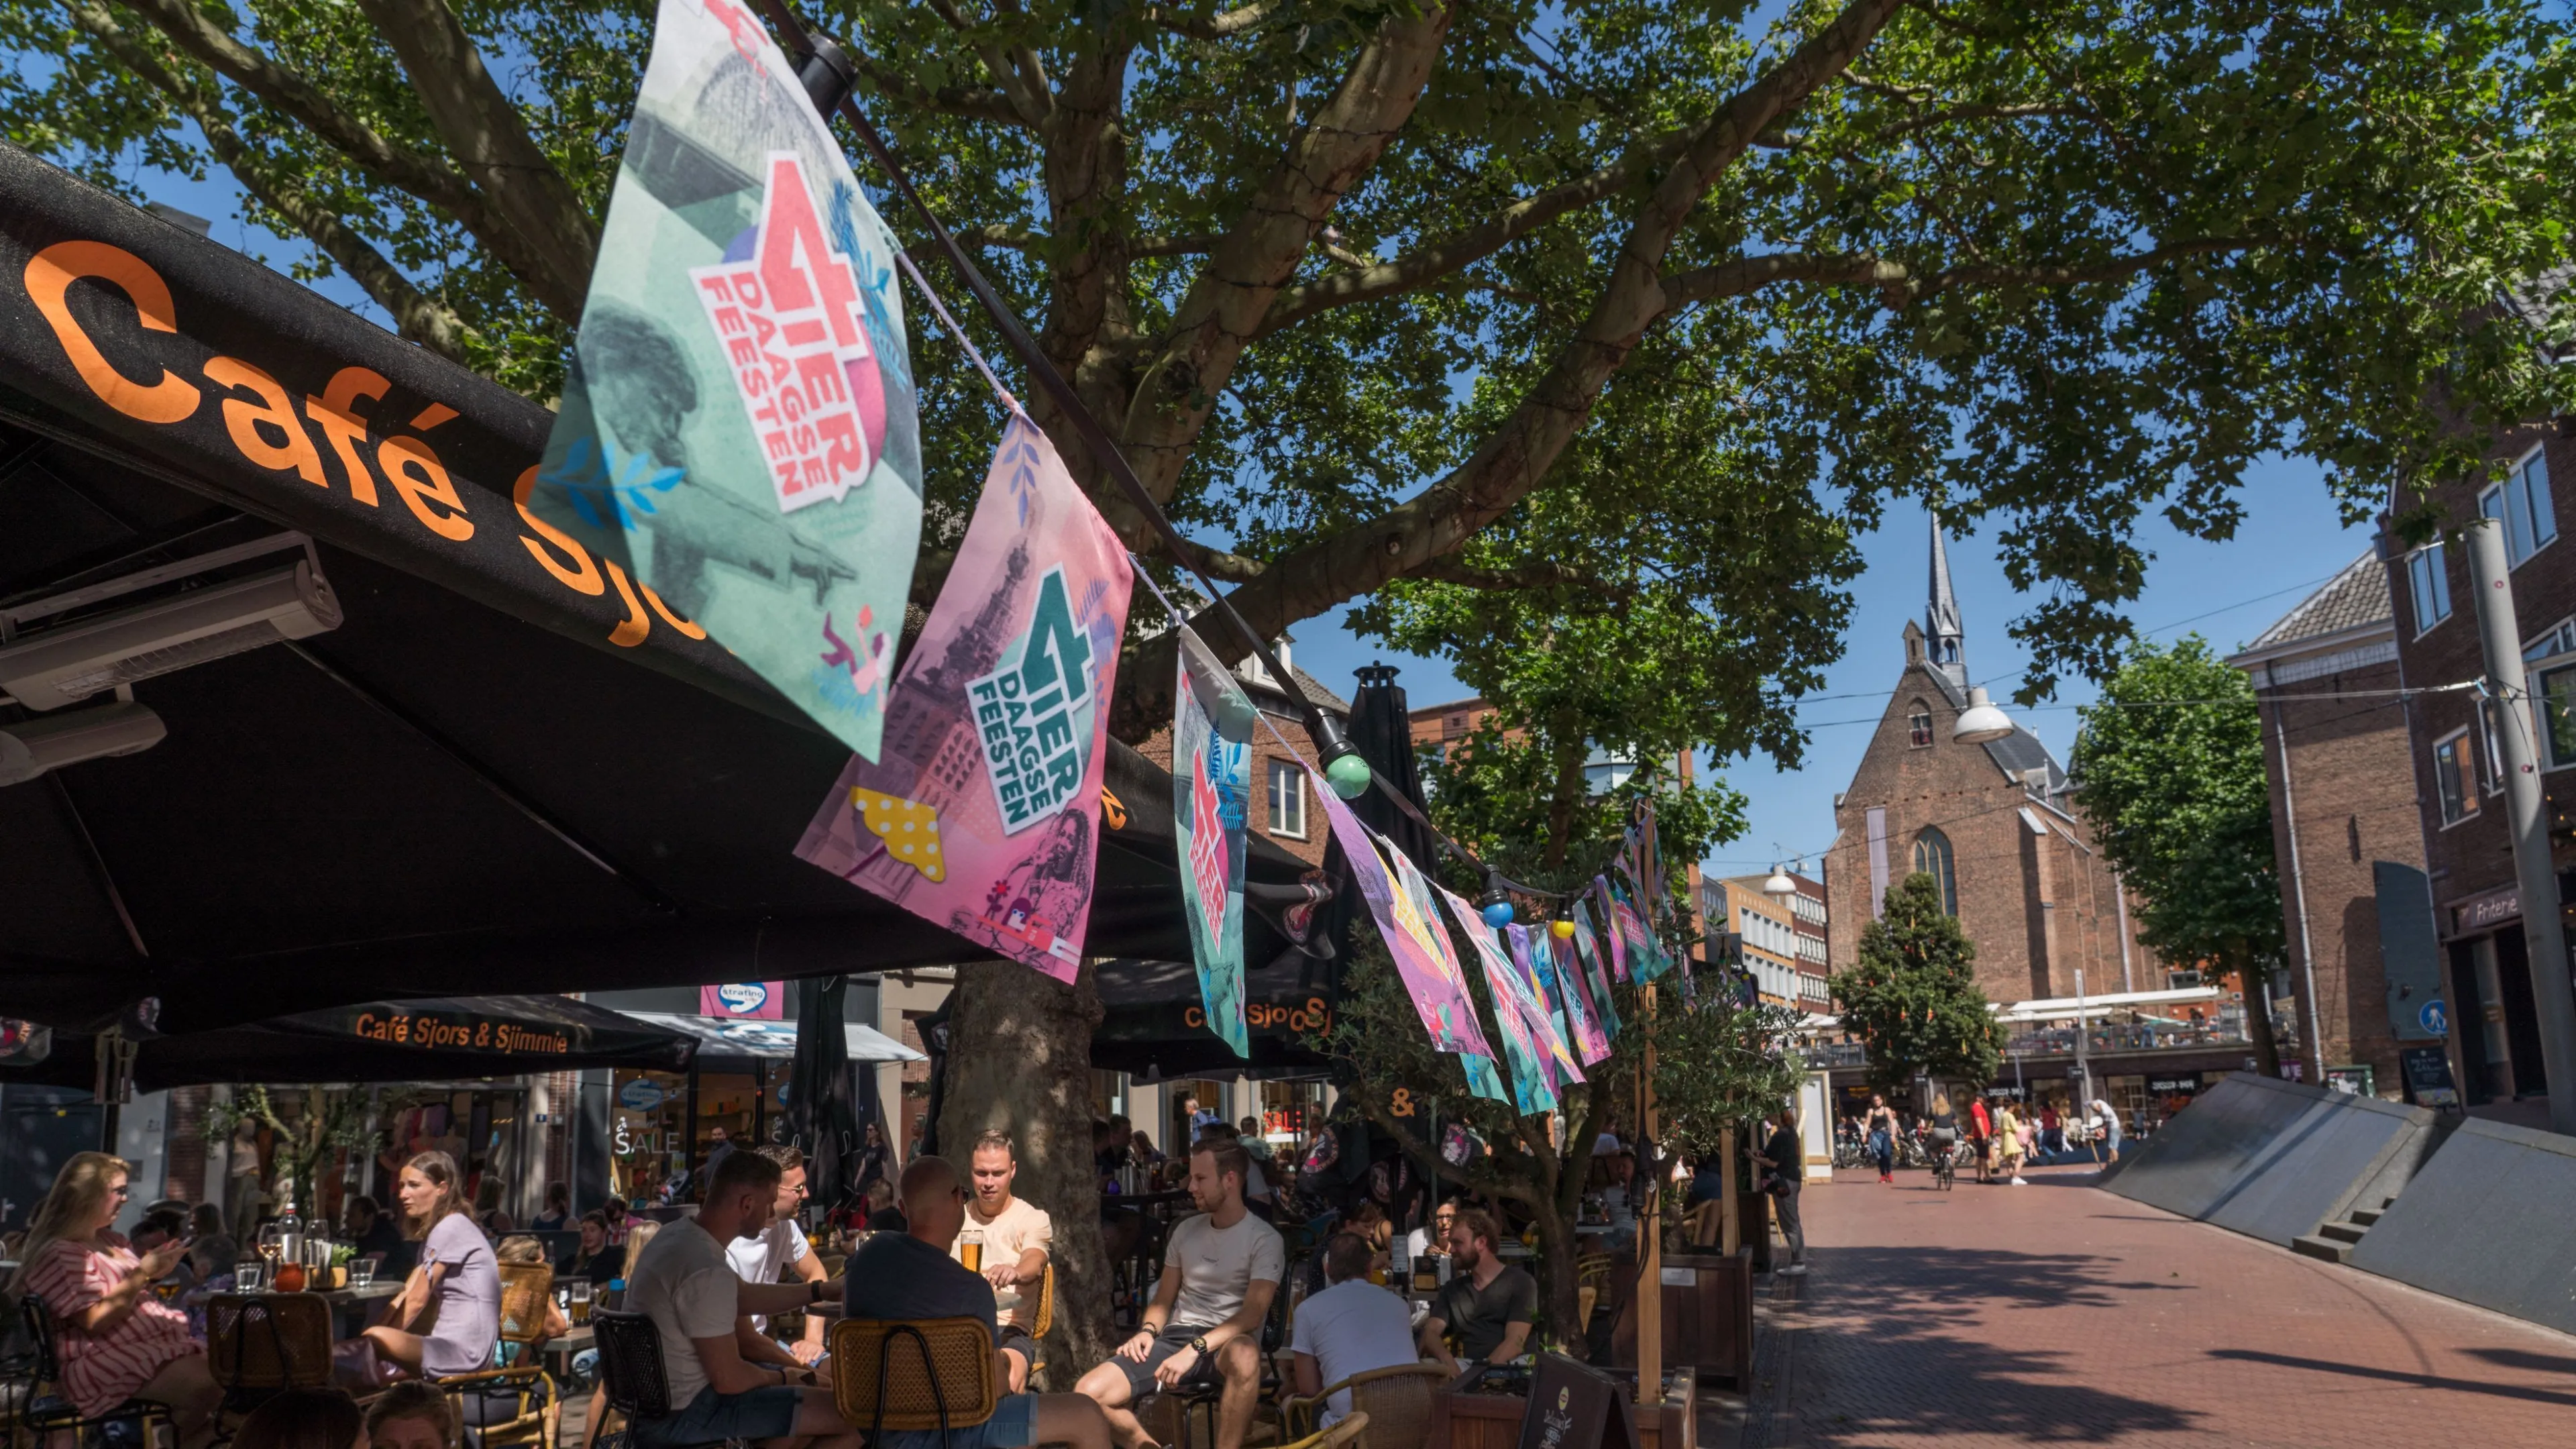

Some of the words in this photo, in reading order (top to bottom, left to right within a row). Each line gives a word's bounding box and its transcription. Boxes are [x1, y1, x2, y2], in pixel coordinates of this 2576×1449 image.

[24, 240, 474, 541] Café
[700, 276, 803, 497] FEESTEN
[731, 271, 826, 488] DAAGSE
[973, 681, 1029, 824] FEESTEN
[998, 672, 1051, 811] DAAGSE
[356, 1013, 410, 1042] Café
[414, 1018, 470, 1049] Sjors
[475, 1022, 490, 1046] &
[496, 1024, 568, 1054] Sjimmie
[722, 989, 763, 998] strating
[615, 1132, 680, 1155] SALE
[1391, 1087, 1415, 1117] &
